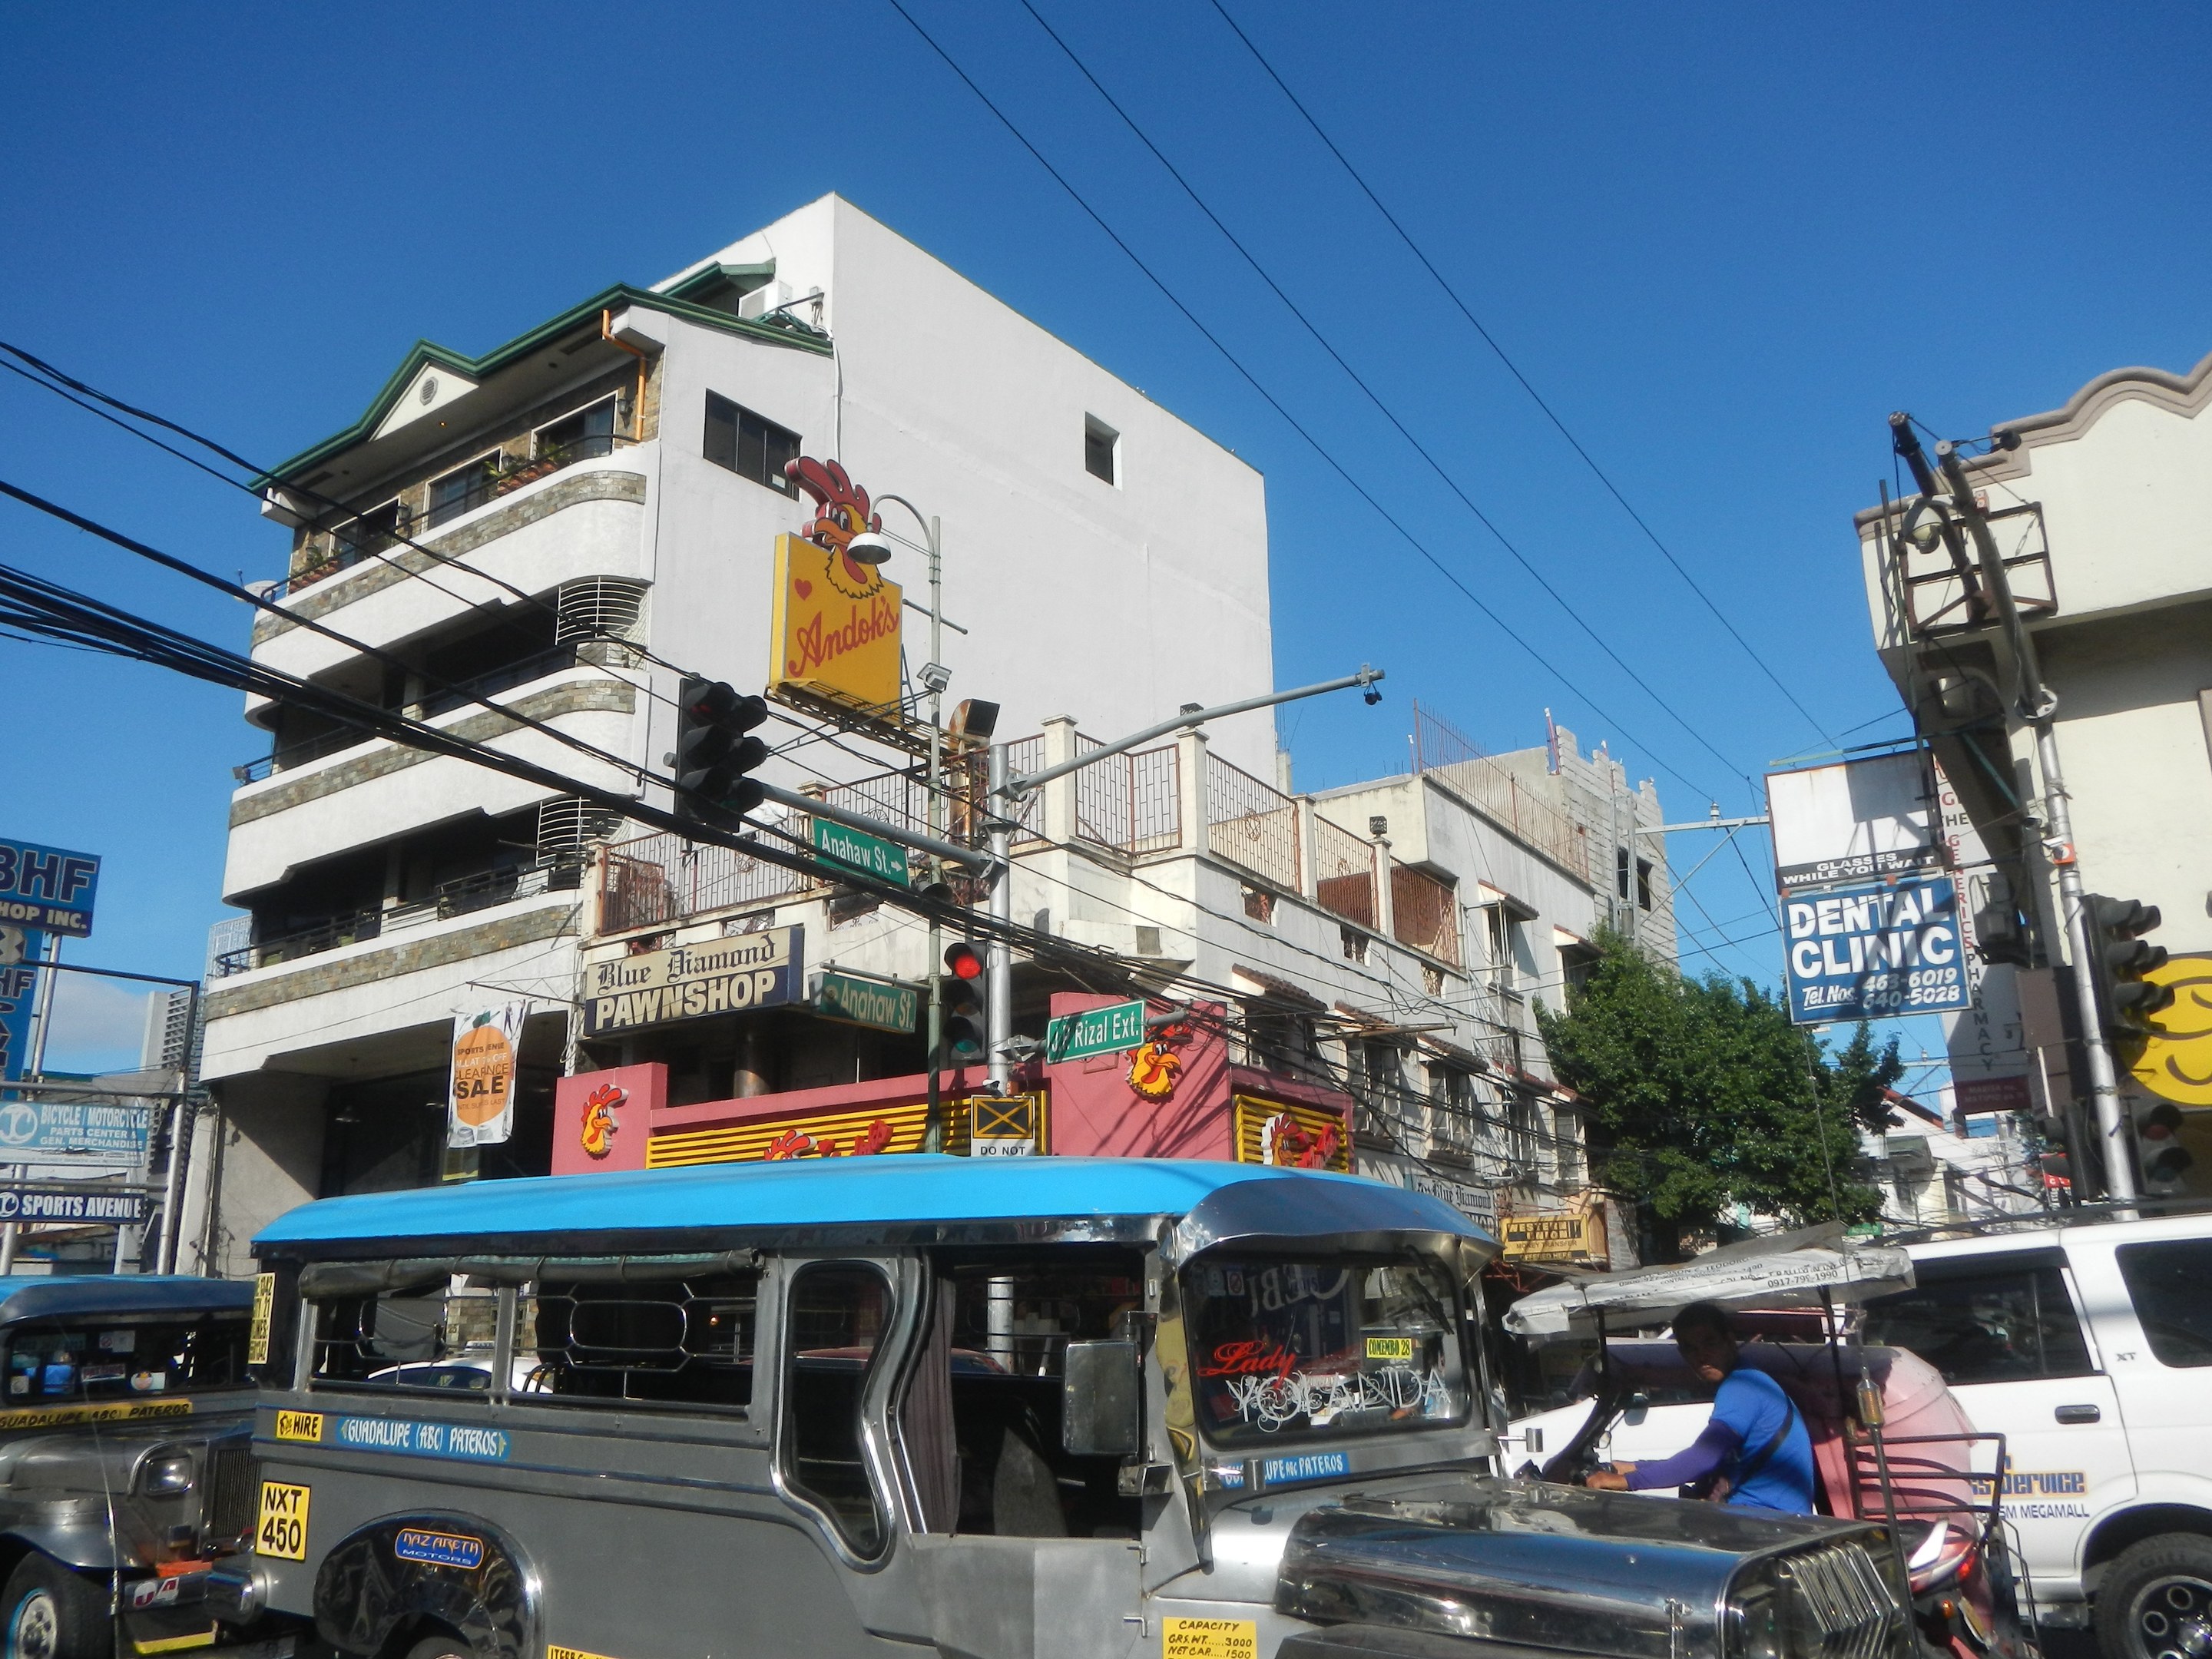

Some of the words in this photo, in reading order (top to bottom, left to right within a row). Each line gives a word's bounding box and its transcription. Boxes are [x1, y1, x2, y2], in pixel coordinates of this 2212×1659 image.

[788, 595, 899, 677] Andok's
[822, 829, 870, 868] Anahaw
[875, 845, 891, 874] St.
[1816, 853, 1897, 872] GLASSES
[0, 845, 97, 902] BHF
[1783, 869, 1838, 884] WHILE
[1844, 864, 1881, 876] YOU
[47, 909, 87, 929] INC.
[1788, 888, 1949, 939] DENTAL
[1792, 926, 1954, 979] CLINIC
[1942, 813, 1969, 827] HE
[1965, 953, 1992, 1071] PHARMACY
[597, 962, 651, 995] Blue
[667, 933, 776, 984] Diamond
[1862, 967, 1958, 991] 463-6019
[595, 970, 776, 1030] PAWNSHOP
[840, 979, 896, 1025] Anahaw
[899, 991, 913, 1029] St.
[1863, 985, 1960, 1009] 640-5028
[1075, 1016, 1108, 1048] Rizal
[1113, 1011, 1139, 1040] Ext.
[41, 1105, 81, 1126] BICYCLE
[41, 1137, 65, 1145] GEN.
[68, 1137, 143, 1149] MERCHANDISE
[50, 1127, 84, 1137] PARTS
[87, 1128, 127, 1138] CENTER
[980, 1147, 996, 1155] DO
[1002, 1147, 1025, 1155] NOT
[22, 1194, 84, 1217] SPORTS
[85, 1197, 141, 1218] AVENUE
[1516, 1240, 1539, 1249] MONEY
[1541, 1240, 1577, 1249] TRANSFER
[1401, 1339, 1410, 1356] 28
[1197, 1340, 1296, 1390] Lady
[128, 1403, 190, 1417] PATEROS
[1225, 1366, 1451, 1432] YOLANDA
[293, 1415, 319, 1438] HIRE
[348, 1419, 411, 1448] GUADALUPE
[416, 1424, 443, 1451] (ABC)
[449, 1429, 497, 1456] PATEROS
[1299, 1455, 1343, 1477] PATEROS
[264, 1486, 302, 1514] NXT
[2020, 1504, 2090, 1518] MEGAMALL
[262, 1516, 301, 1553] 450
[402, 1548, 471, 1565] MOTORS
[1179, 1621, 1240, 1631] CAPACITY
